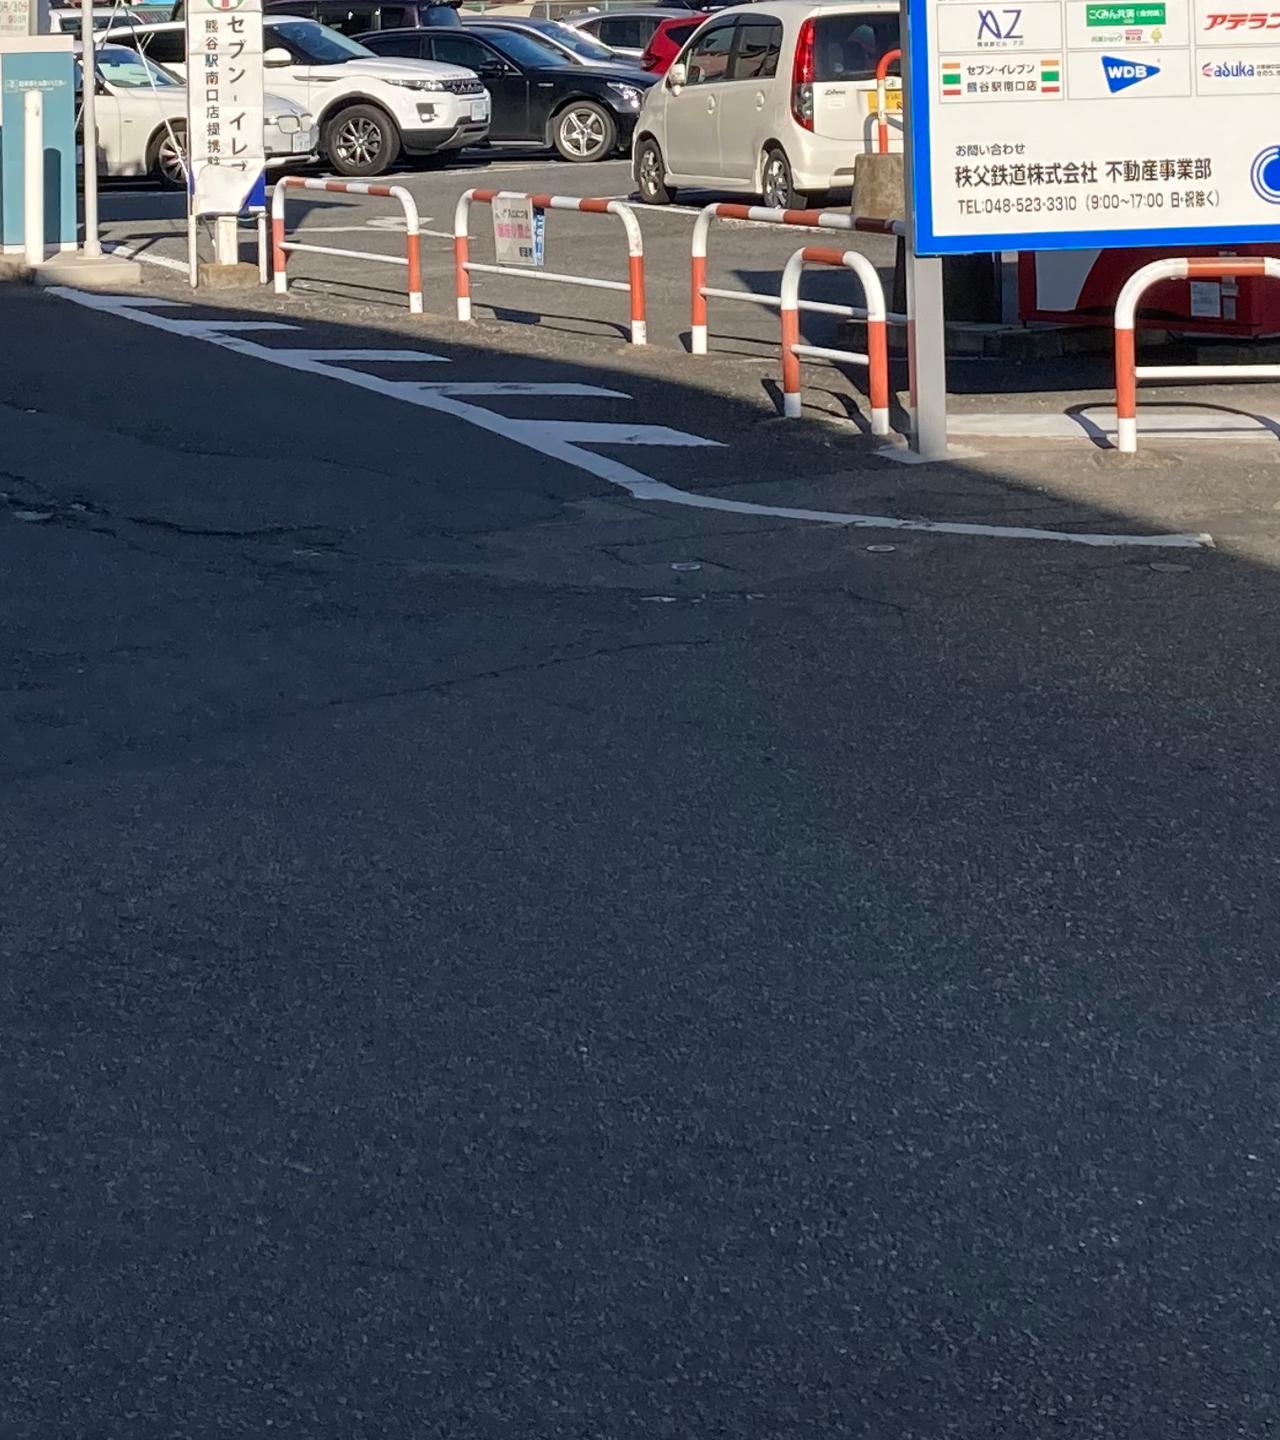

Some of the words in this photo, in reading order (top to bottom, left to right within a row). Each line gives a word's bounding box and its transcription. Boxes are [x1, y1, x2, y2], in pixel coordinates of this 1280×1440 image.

[1108, 66, 1147, 79] WDB
[967, 81, 1037, 93] 熊谷駅南口店
[955, 144, 1025, 157] お問い合わせ
[955, 161, 1098, 187] 秩父鉄道株式会社
[1106, 158, 1212, 183] 不動産事業部
